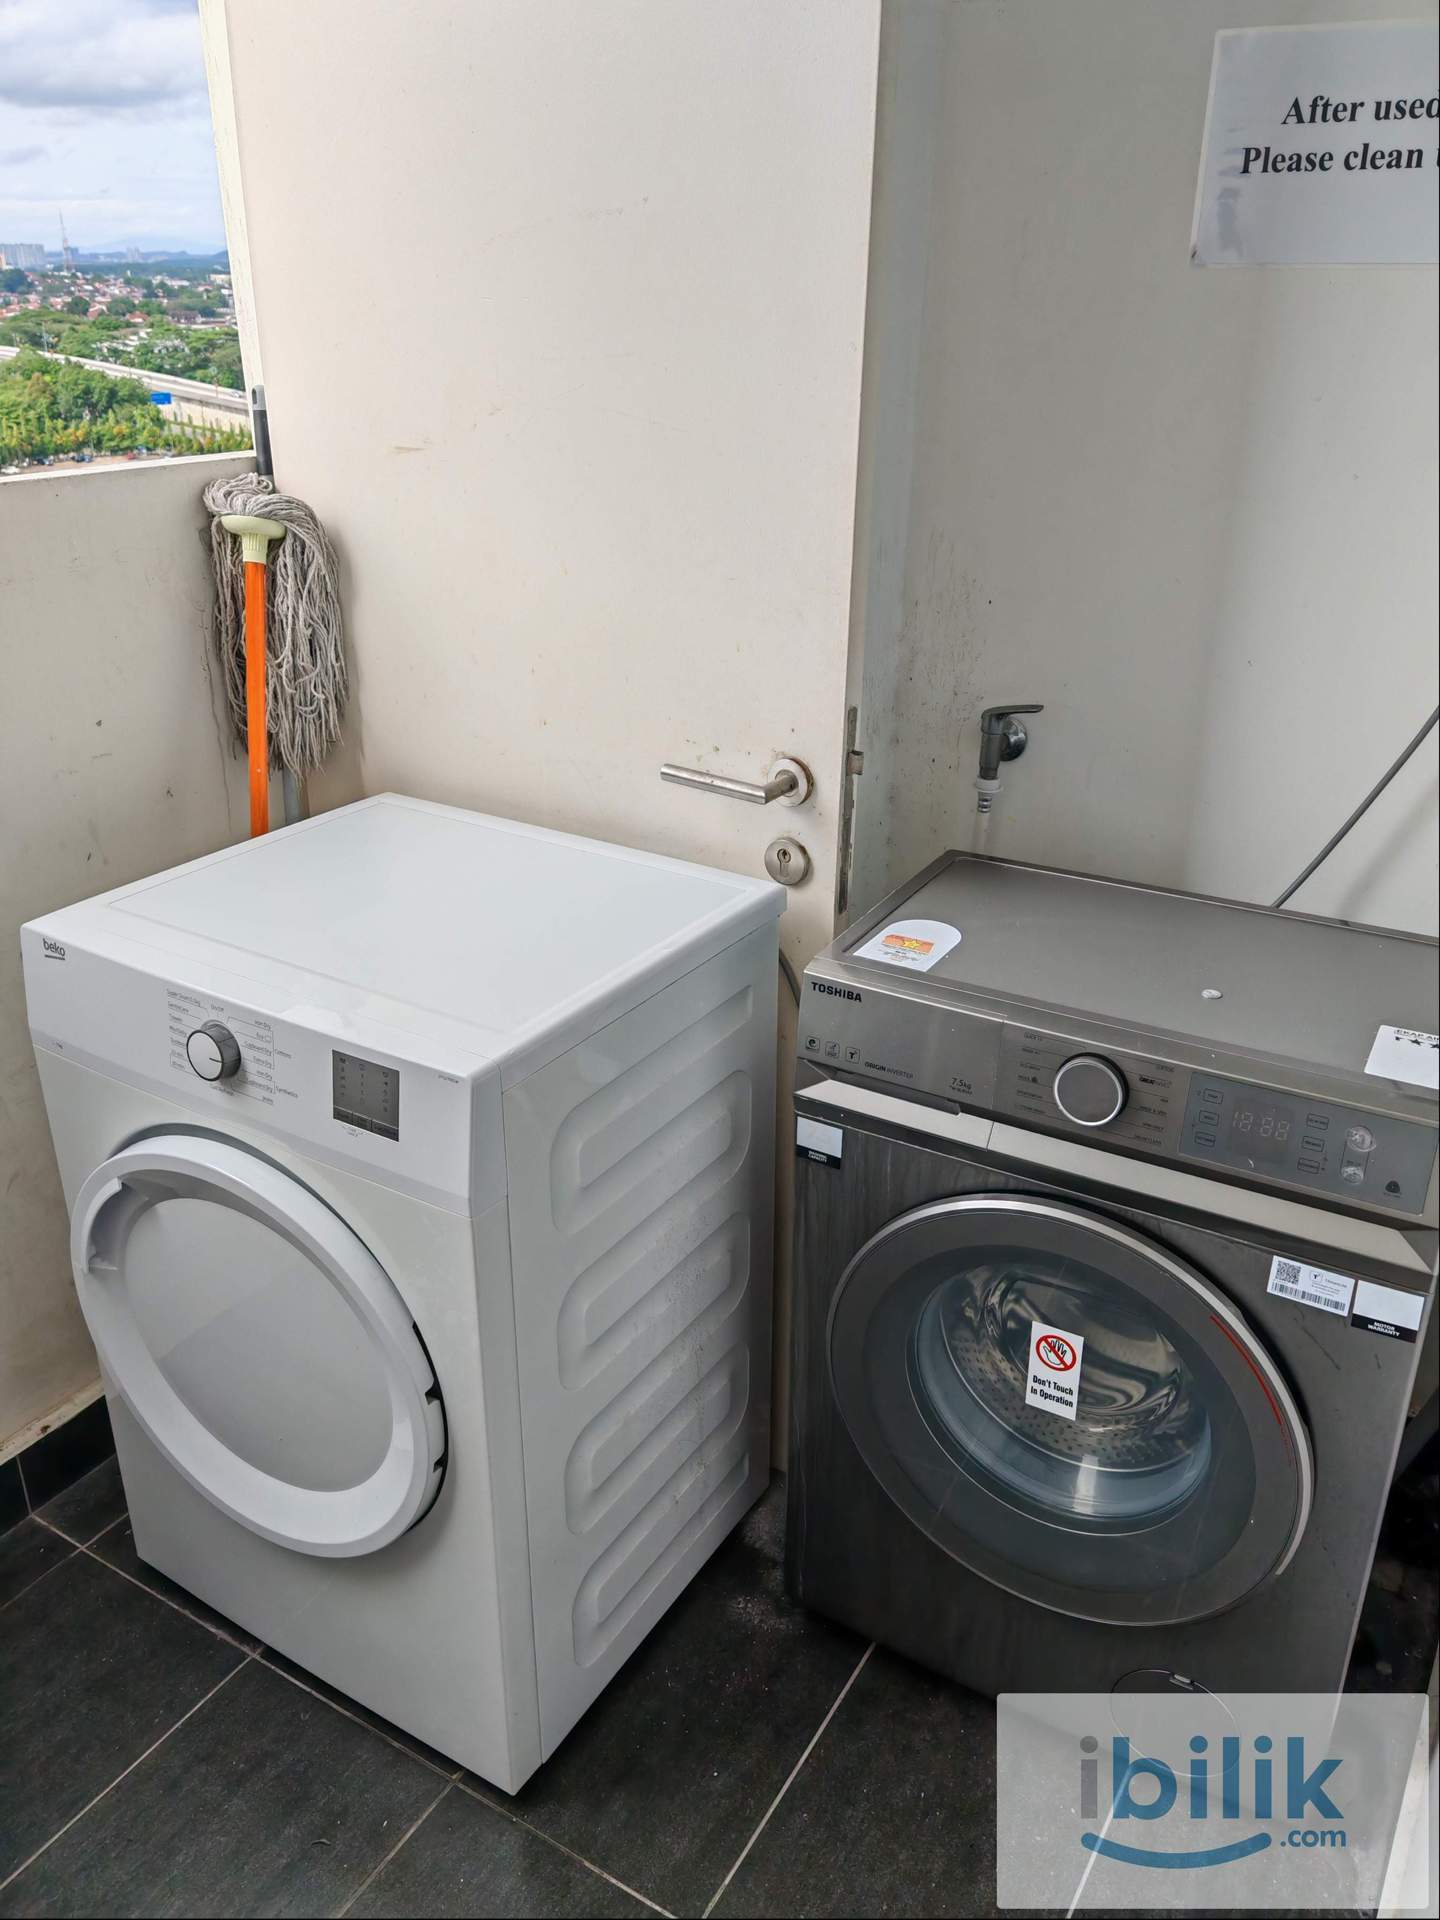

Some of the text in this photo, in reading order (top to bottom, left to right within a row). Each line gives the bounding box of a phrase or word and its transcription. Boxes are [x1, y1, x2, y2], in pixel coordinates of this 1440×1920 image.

[1281, 95, 1365, 125] After
[1240, 146, 1334, 174] Please
[1343, 142, 1424, 171] clean
[43, 938, 66, 957] beko
[811, 981, 862, 1003] TOSHIBA
[1033, 1375, 1074, 1396] Don't Touch
[1030, 1386, 1074, 1408] In Operation
